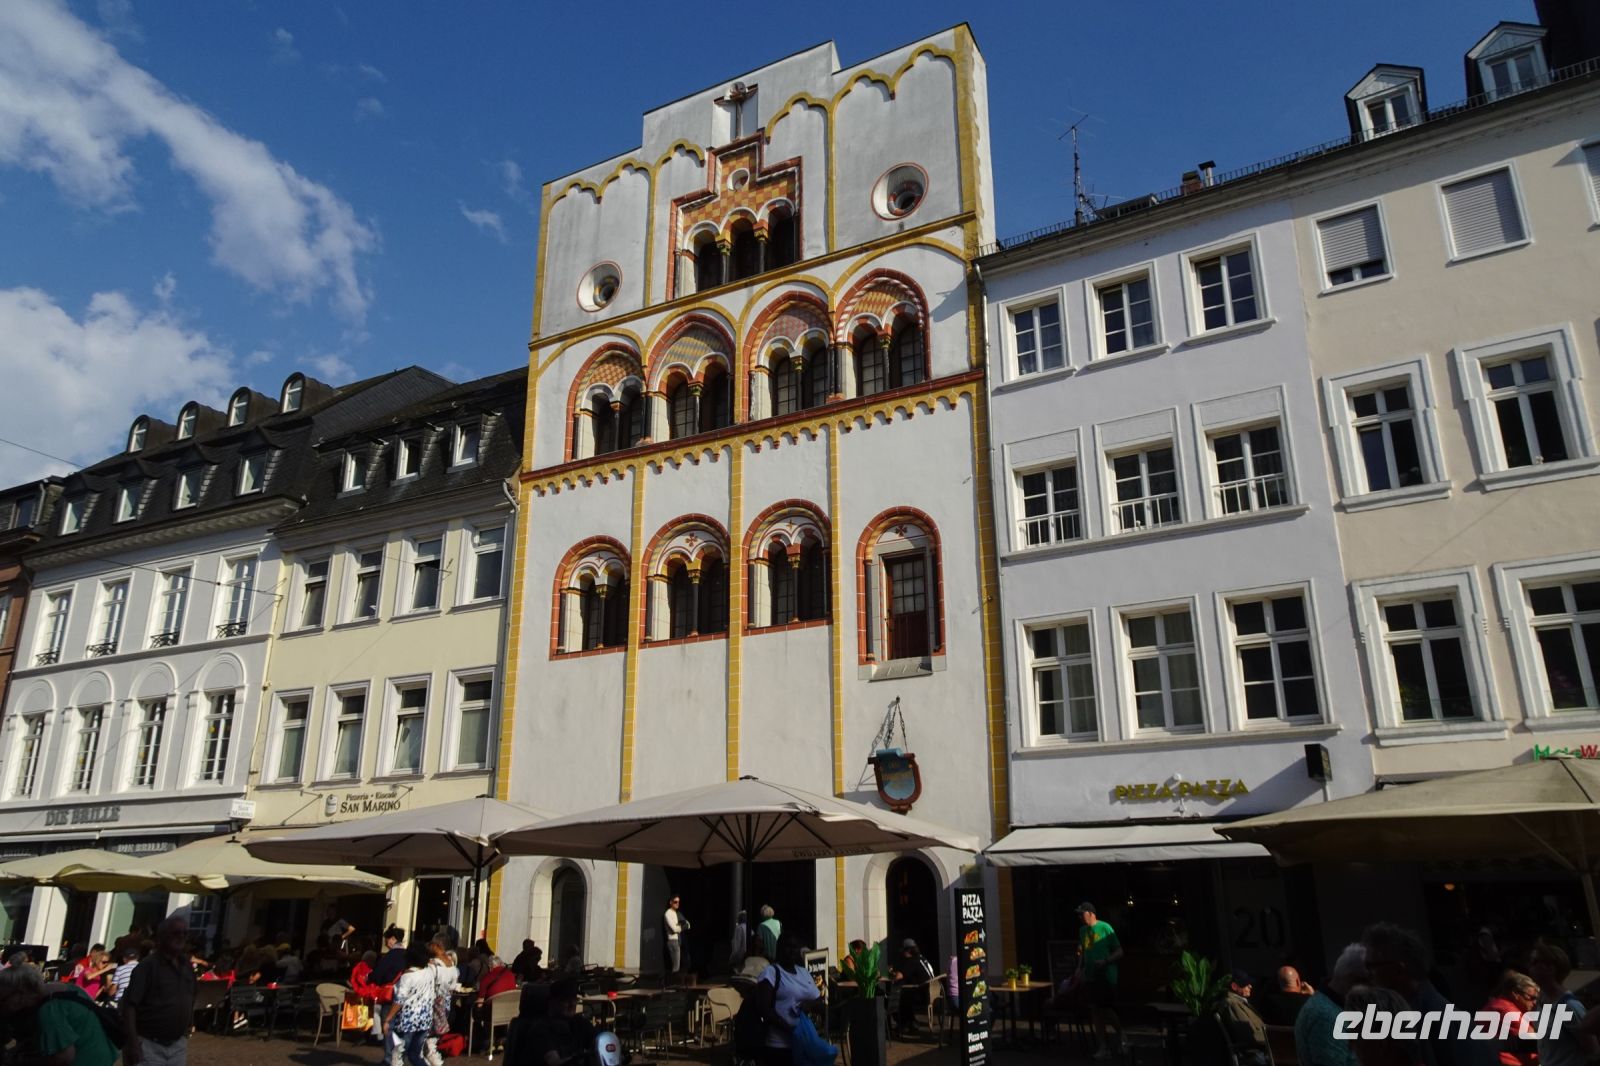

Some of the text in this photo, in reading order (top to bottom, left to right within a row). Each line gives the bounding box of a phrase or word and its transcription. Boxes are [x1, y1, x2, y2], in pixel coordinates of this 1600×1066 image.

[1114, 778, 1249, 801] PIZZA PAZZA
[340, 800, 401, 813] SAN MARINO
[45, 805, 120, 826] DIE BRILLE
[962, 894, 981, 906] PIZZA
[963, 906, 983, 921] PAZZA
